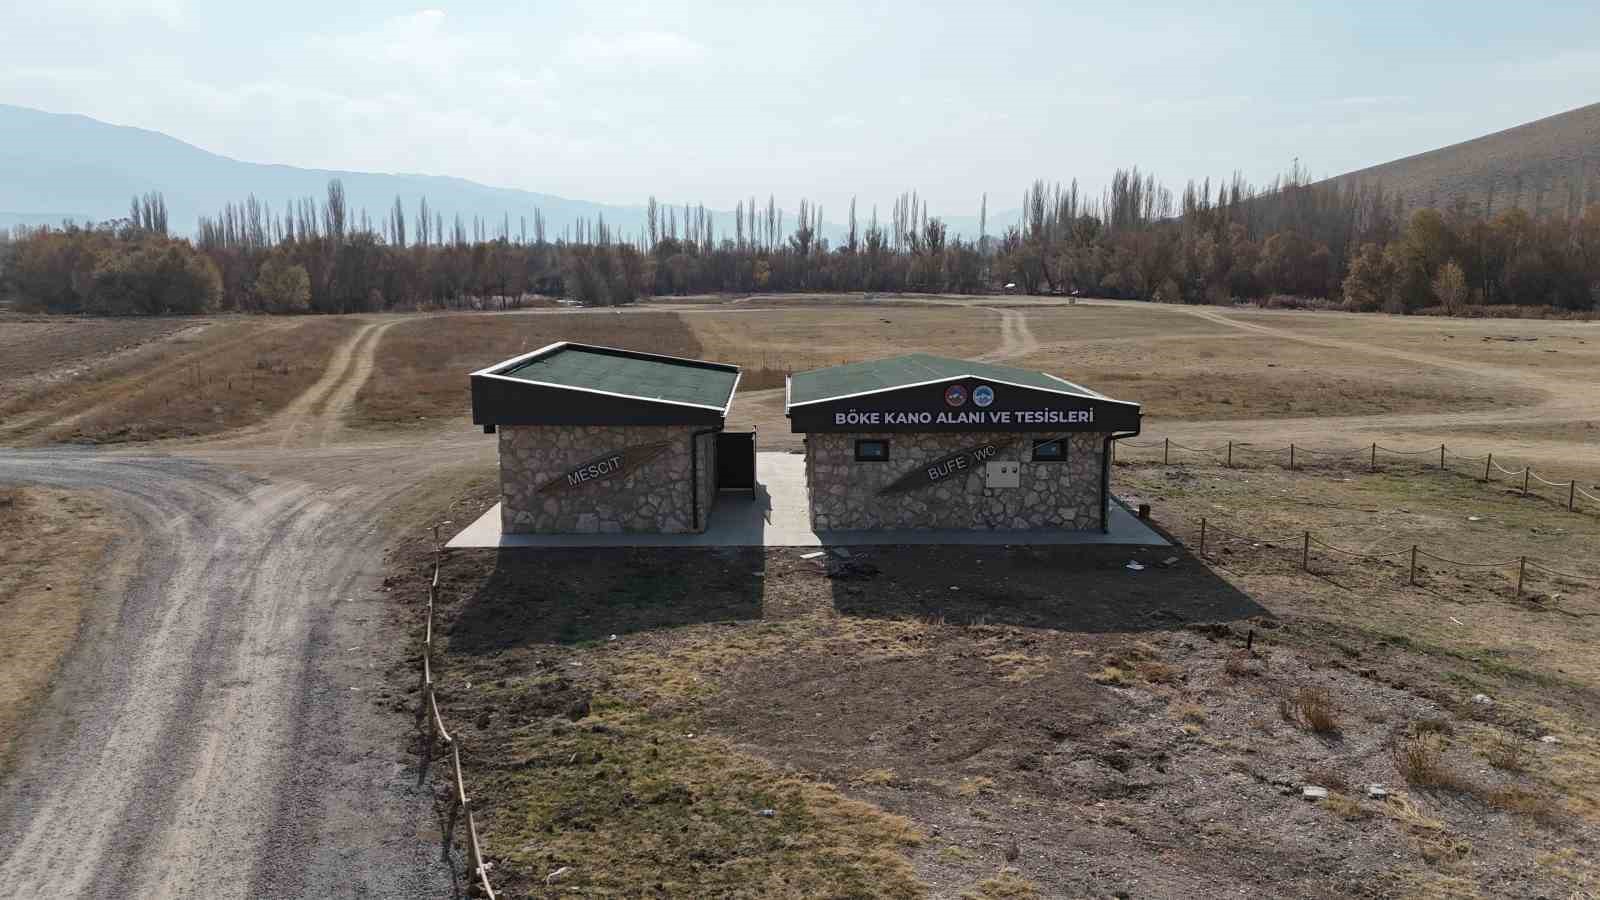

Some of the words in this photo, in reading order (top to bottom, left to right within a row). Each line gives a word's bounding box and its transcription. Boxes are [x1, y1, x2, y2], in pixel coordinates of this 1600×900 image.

[835, 409, 881, 425] BÖKE
[885, 411, 932, 425] KANO
[936, 411, 985, 424] ALANI
[989, 411, 1010, 424] VE
[1014, 407, 1094, 423] TESİSLERİ
[974, 446, 996, 461] WC
